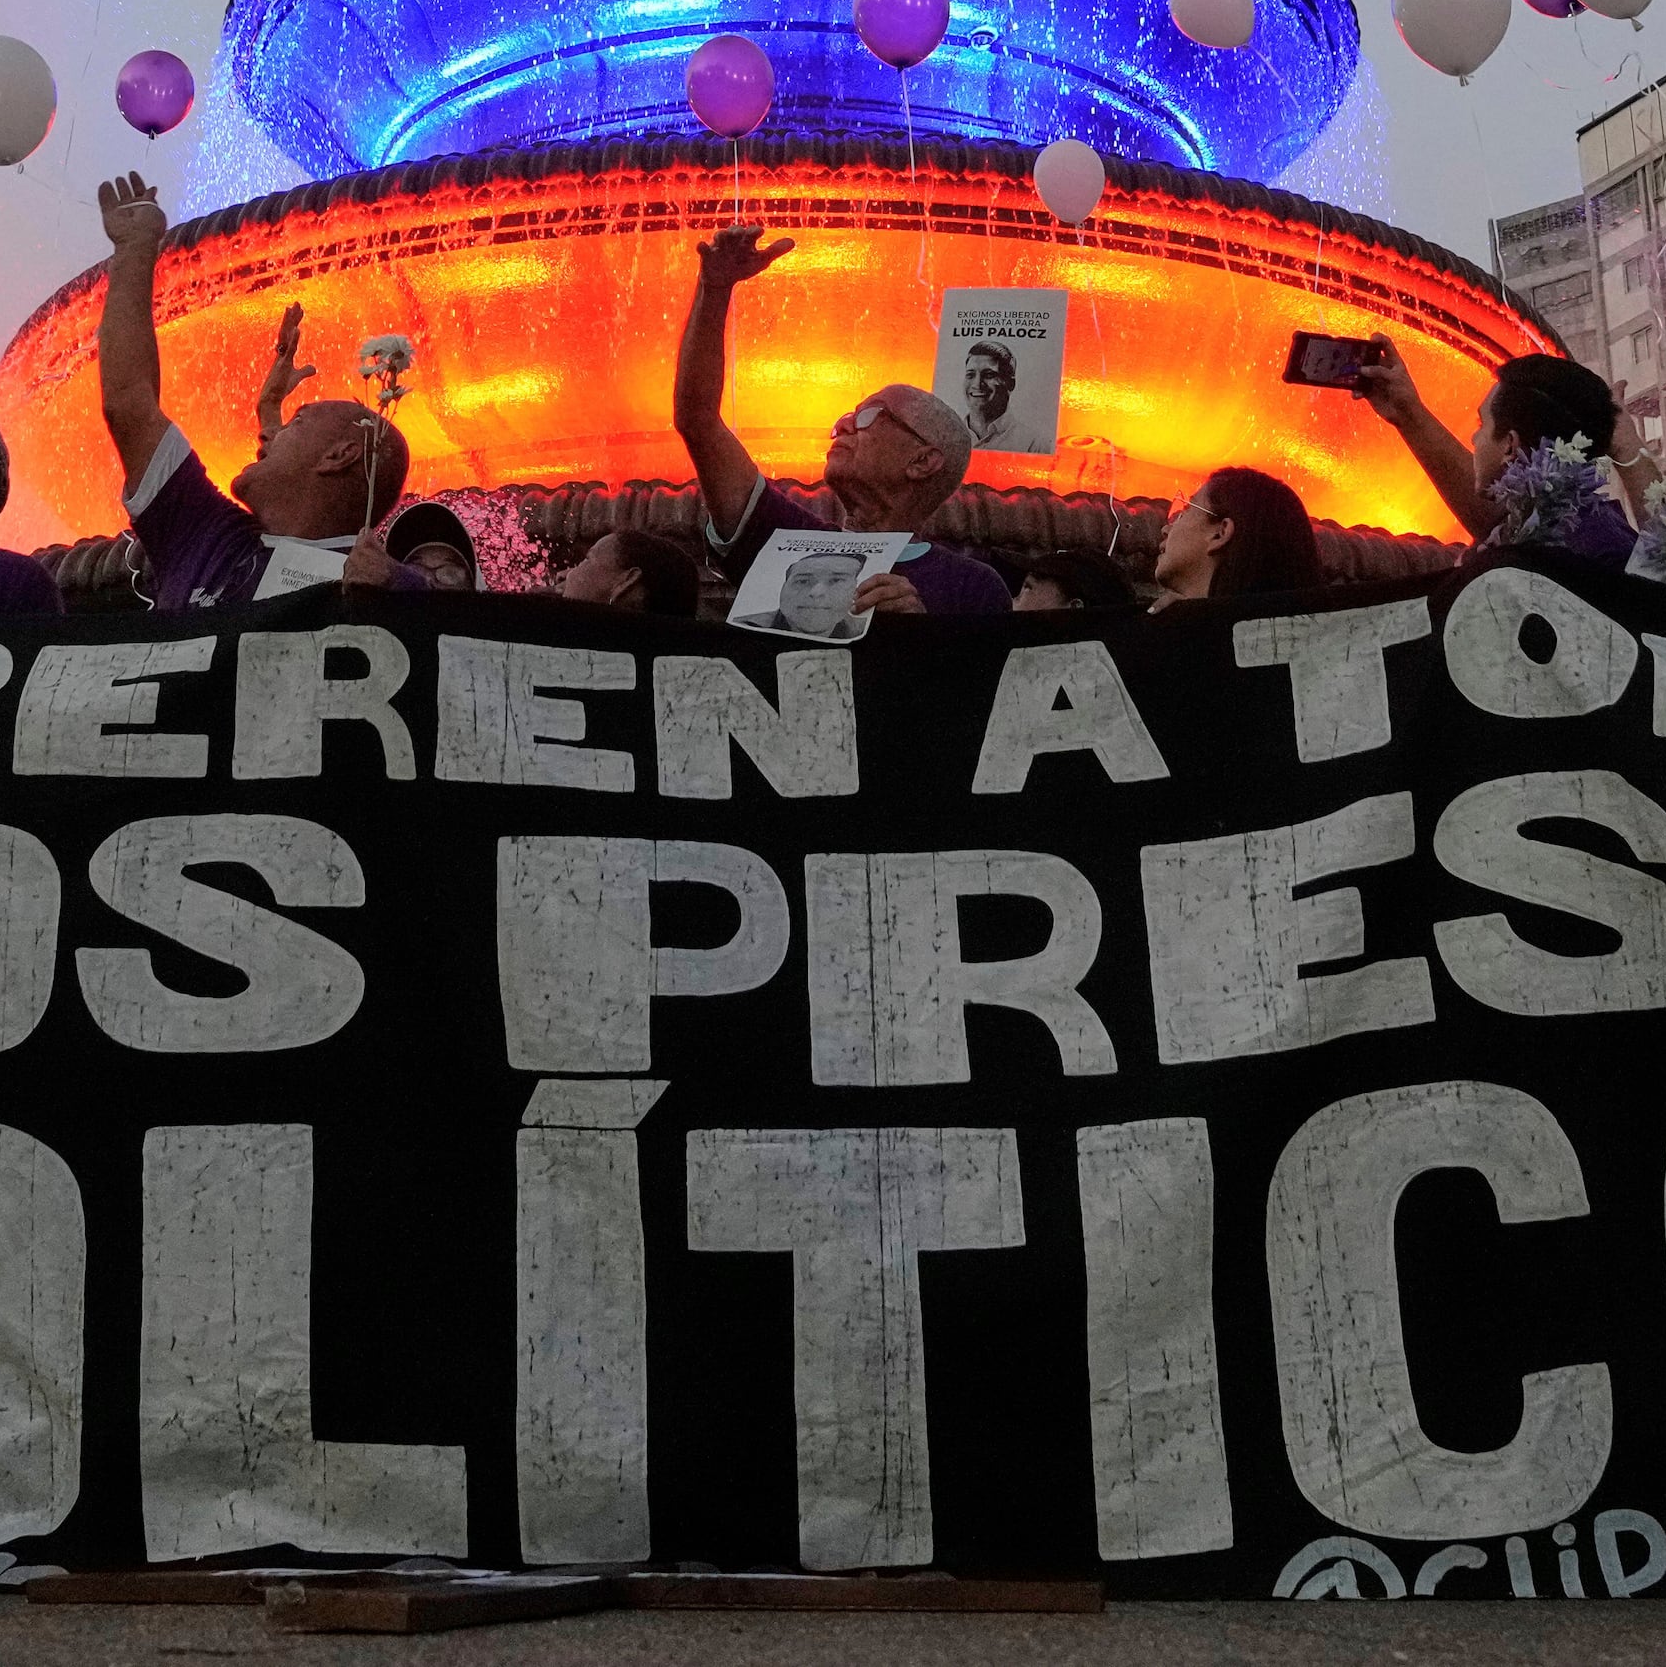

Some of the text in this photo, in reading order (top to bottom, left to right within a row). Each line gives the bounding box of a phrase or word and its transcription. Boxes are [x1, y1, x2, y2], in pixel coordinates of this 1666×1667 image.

[957, 310, 1050, 320] EXIGIMOS LIBERTAD
[961, 318, 1041, 327] INMEDIATA PARA
[952, 327, 1047, 339] LUIS PALOCZ
[281, 567, 314, 582] EXIGIMOS
[971, 640, 1170, 795] A
